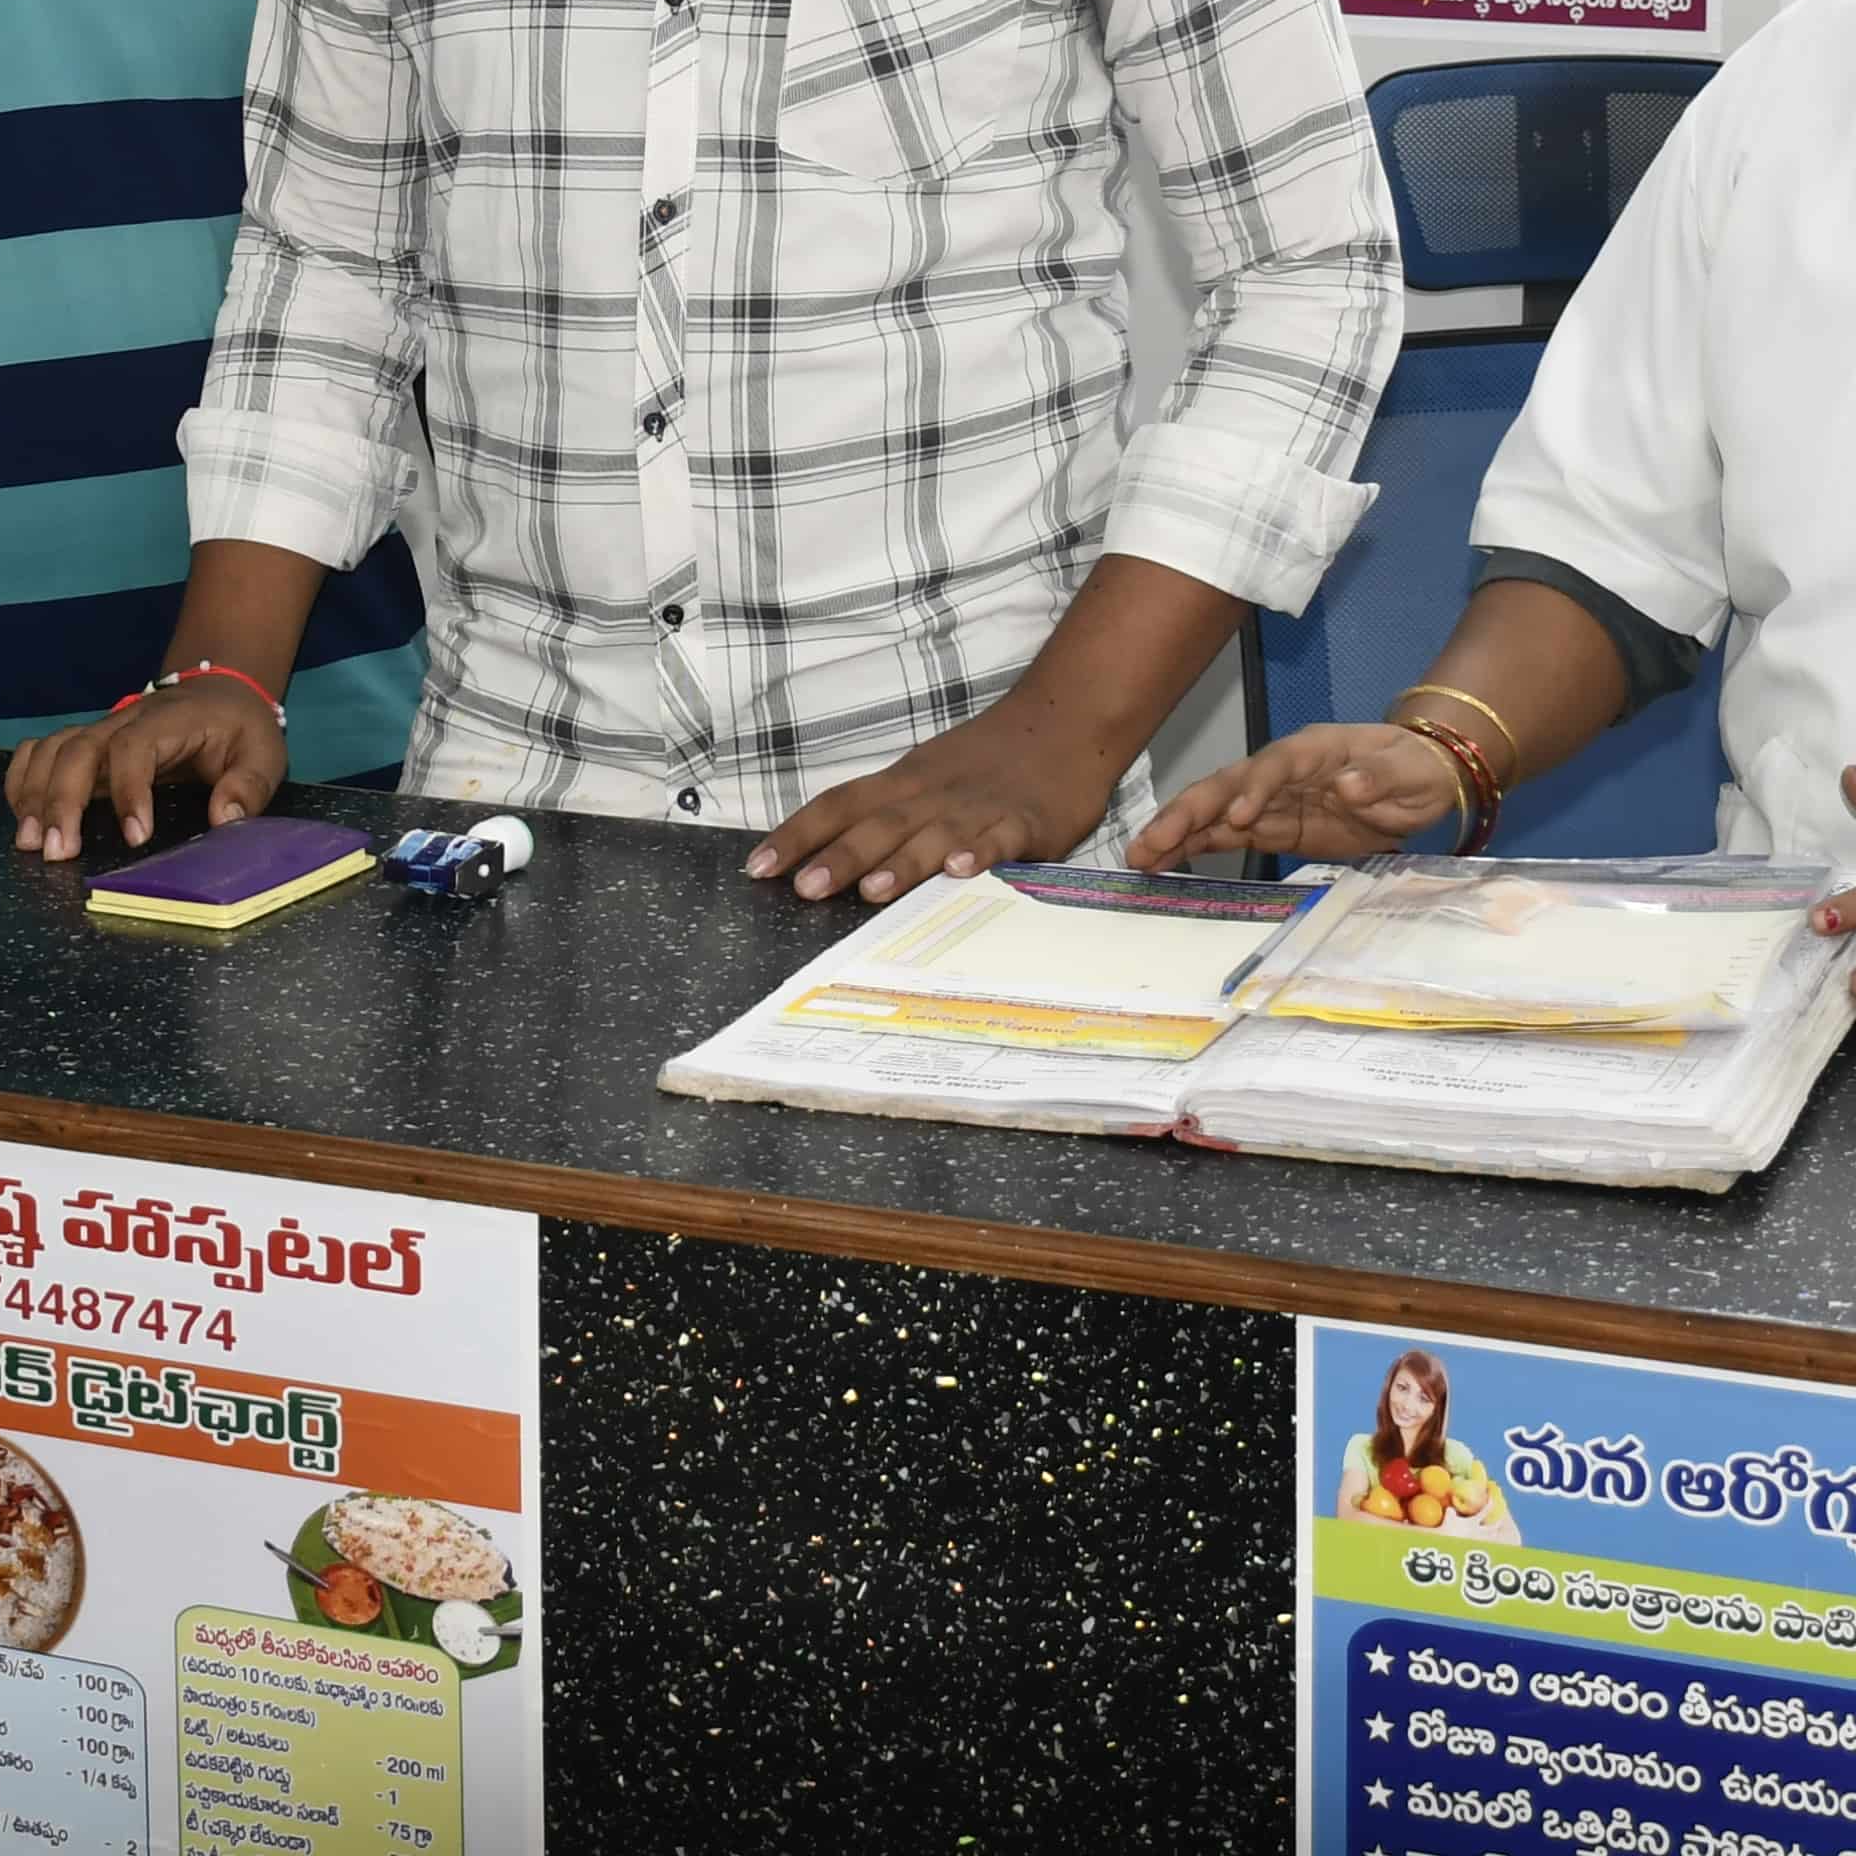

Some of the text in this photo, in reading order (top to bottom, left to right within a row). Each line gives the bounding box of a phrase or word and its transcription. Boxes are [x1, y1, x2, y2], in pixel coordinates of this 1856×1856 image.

[62, 1187, 427, 1298] హాస్పటల్
[1506, 1423, 1648, 1506] మన
[1405, 1547, 1764, 1634] ఈ క్రింది సూత్రాలను
[196, 1624, 439, 1684] మధ్యలో తీసుకోవలసిన ఆహారం
[1408, 1648, 1519, 1696] మంచి
[1529, 1667, 1670, 1721] ఆహారం
[387, 1756, 422, 1778] 200
[1408, 1710, 1497, 1758] రోజూ
[1504, 1733, 1702, 1786] వ్యాయామం
[1407, 1782, 1533, 1830] మనలో
